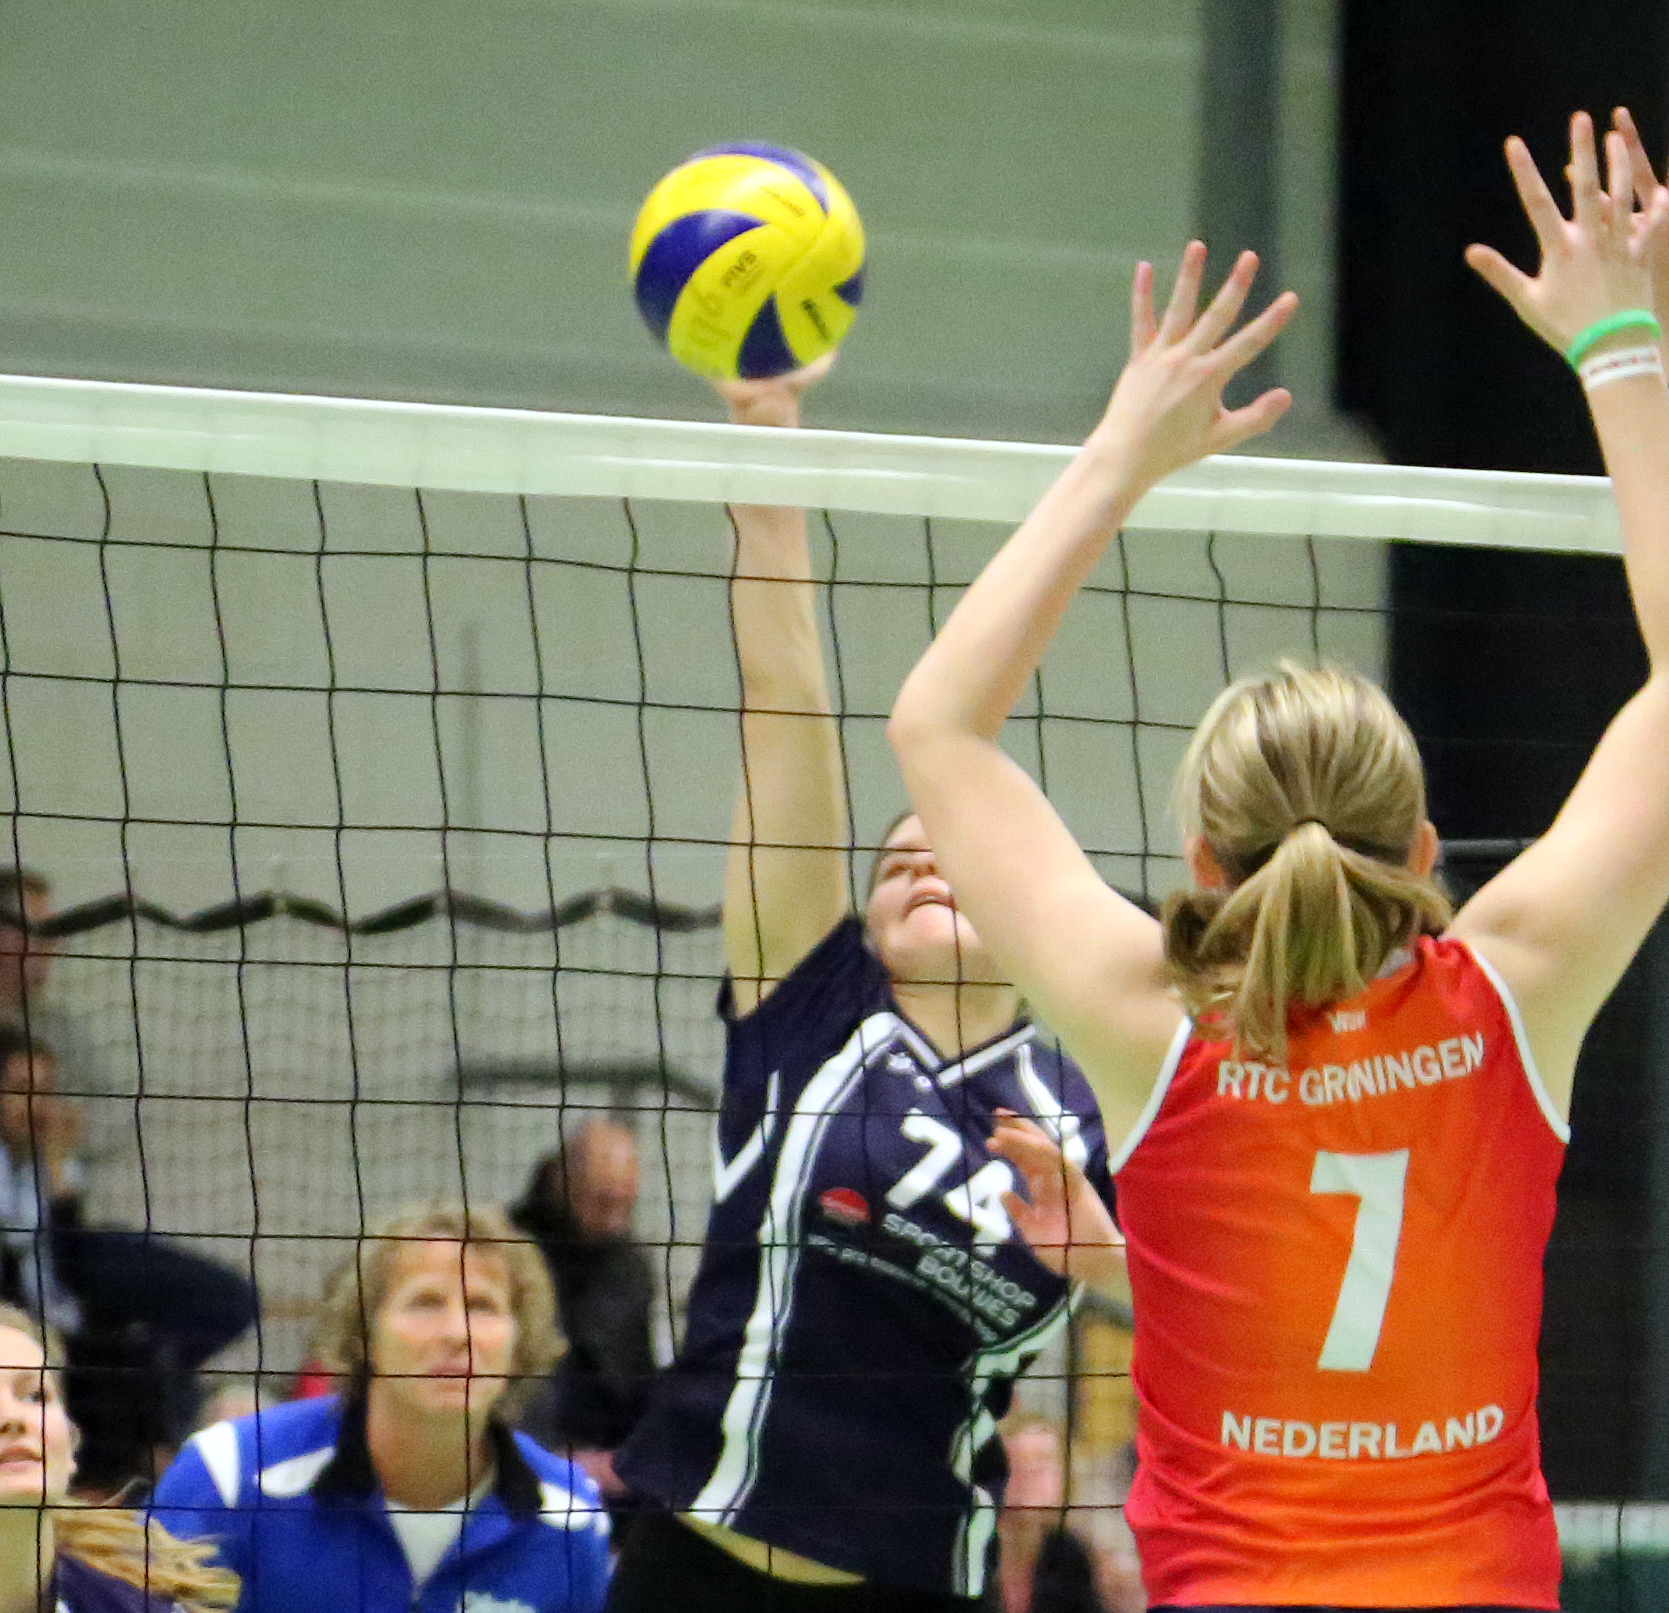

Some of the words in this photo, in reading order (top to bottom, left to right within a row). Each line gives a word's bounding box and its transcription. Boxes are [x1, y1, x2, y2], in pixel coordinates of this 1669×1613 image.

[1216, 1060, 1291, 1103] RTC
[1299, 1030, 1484, 1106] GRNINGEN
[1309, 1148, 1410, 1373] 7
[1220, 1405, 1504, 1460] NEDERLAND
